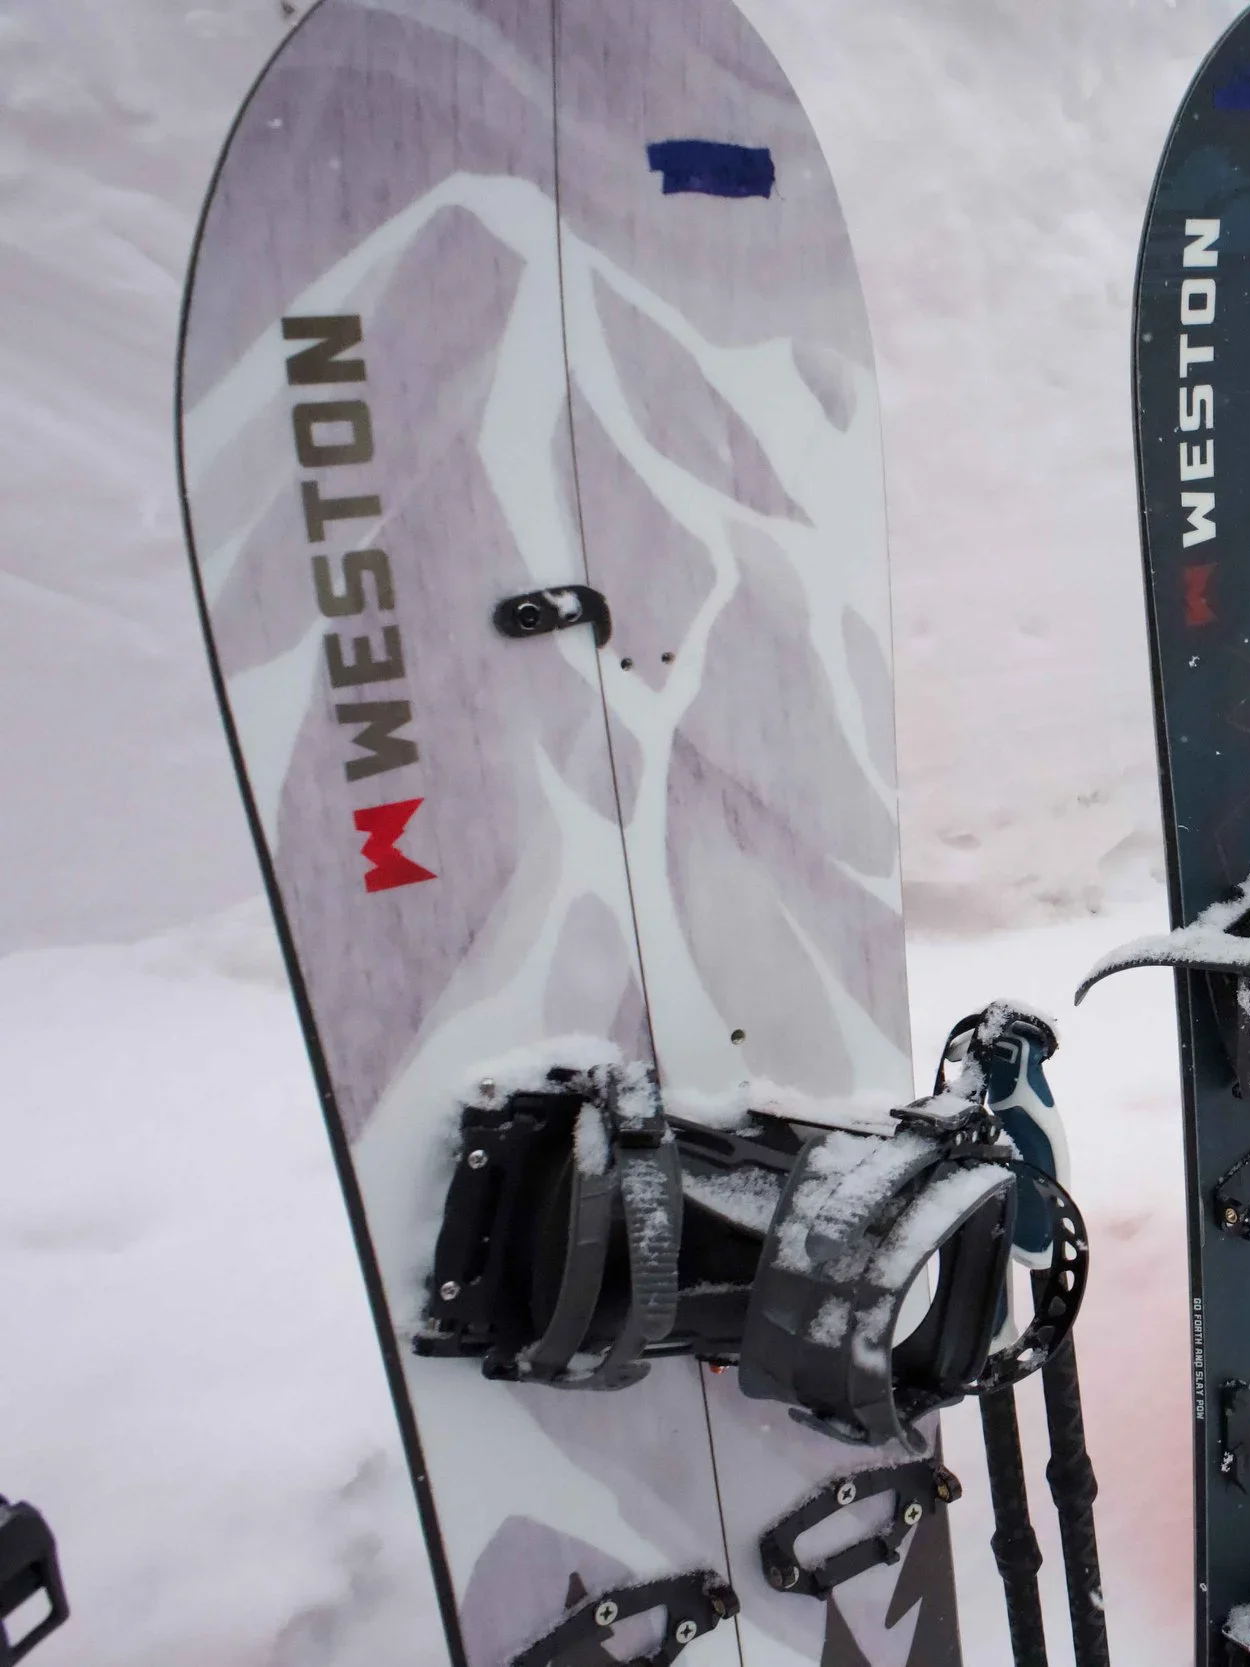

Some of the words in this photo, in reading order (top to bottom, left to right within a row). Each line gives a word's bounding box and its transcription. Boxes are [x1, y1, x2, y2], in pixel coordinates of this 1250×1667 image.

[1179, 218, 1221, 549] WESTON
[281, 314, 420, 783] WESTON
[1193, 1298, 1202, 1311] GO
[1194, 1313, 1203, 1345] FORTH
[1194, 1347, 1204, 1368] AND
[1195, 1371, 1204, 1396] SLAY
[1196, 1399, 1205, 1420] POW
